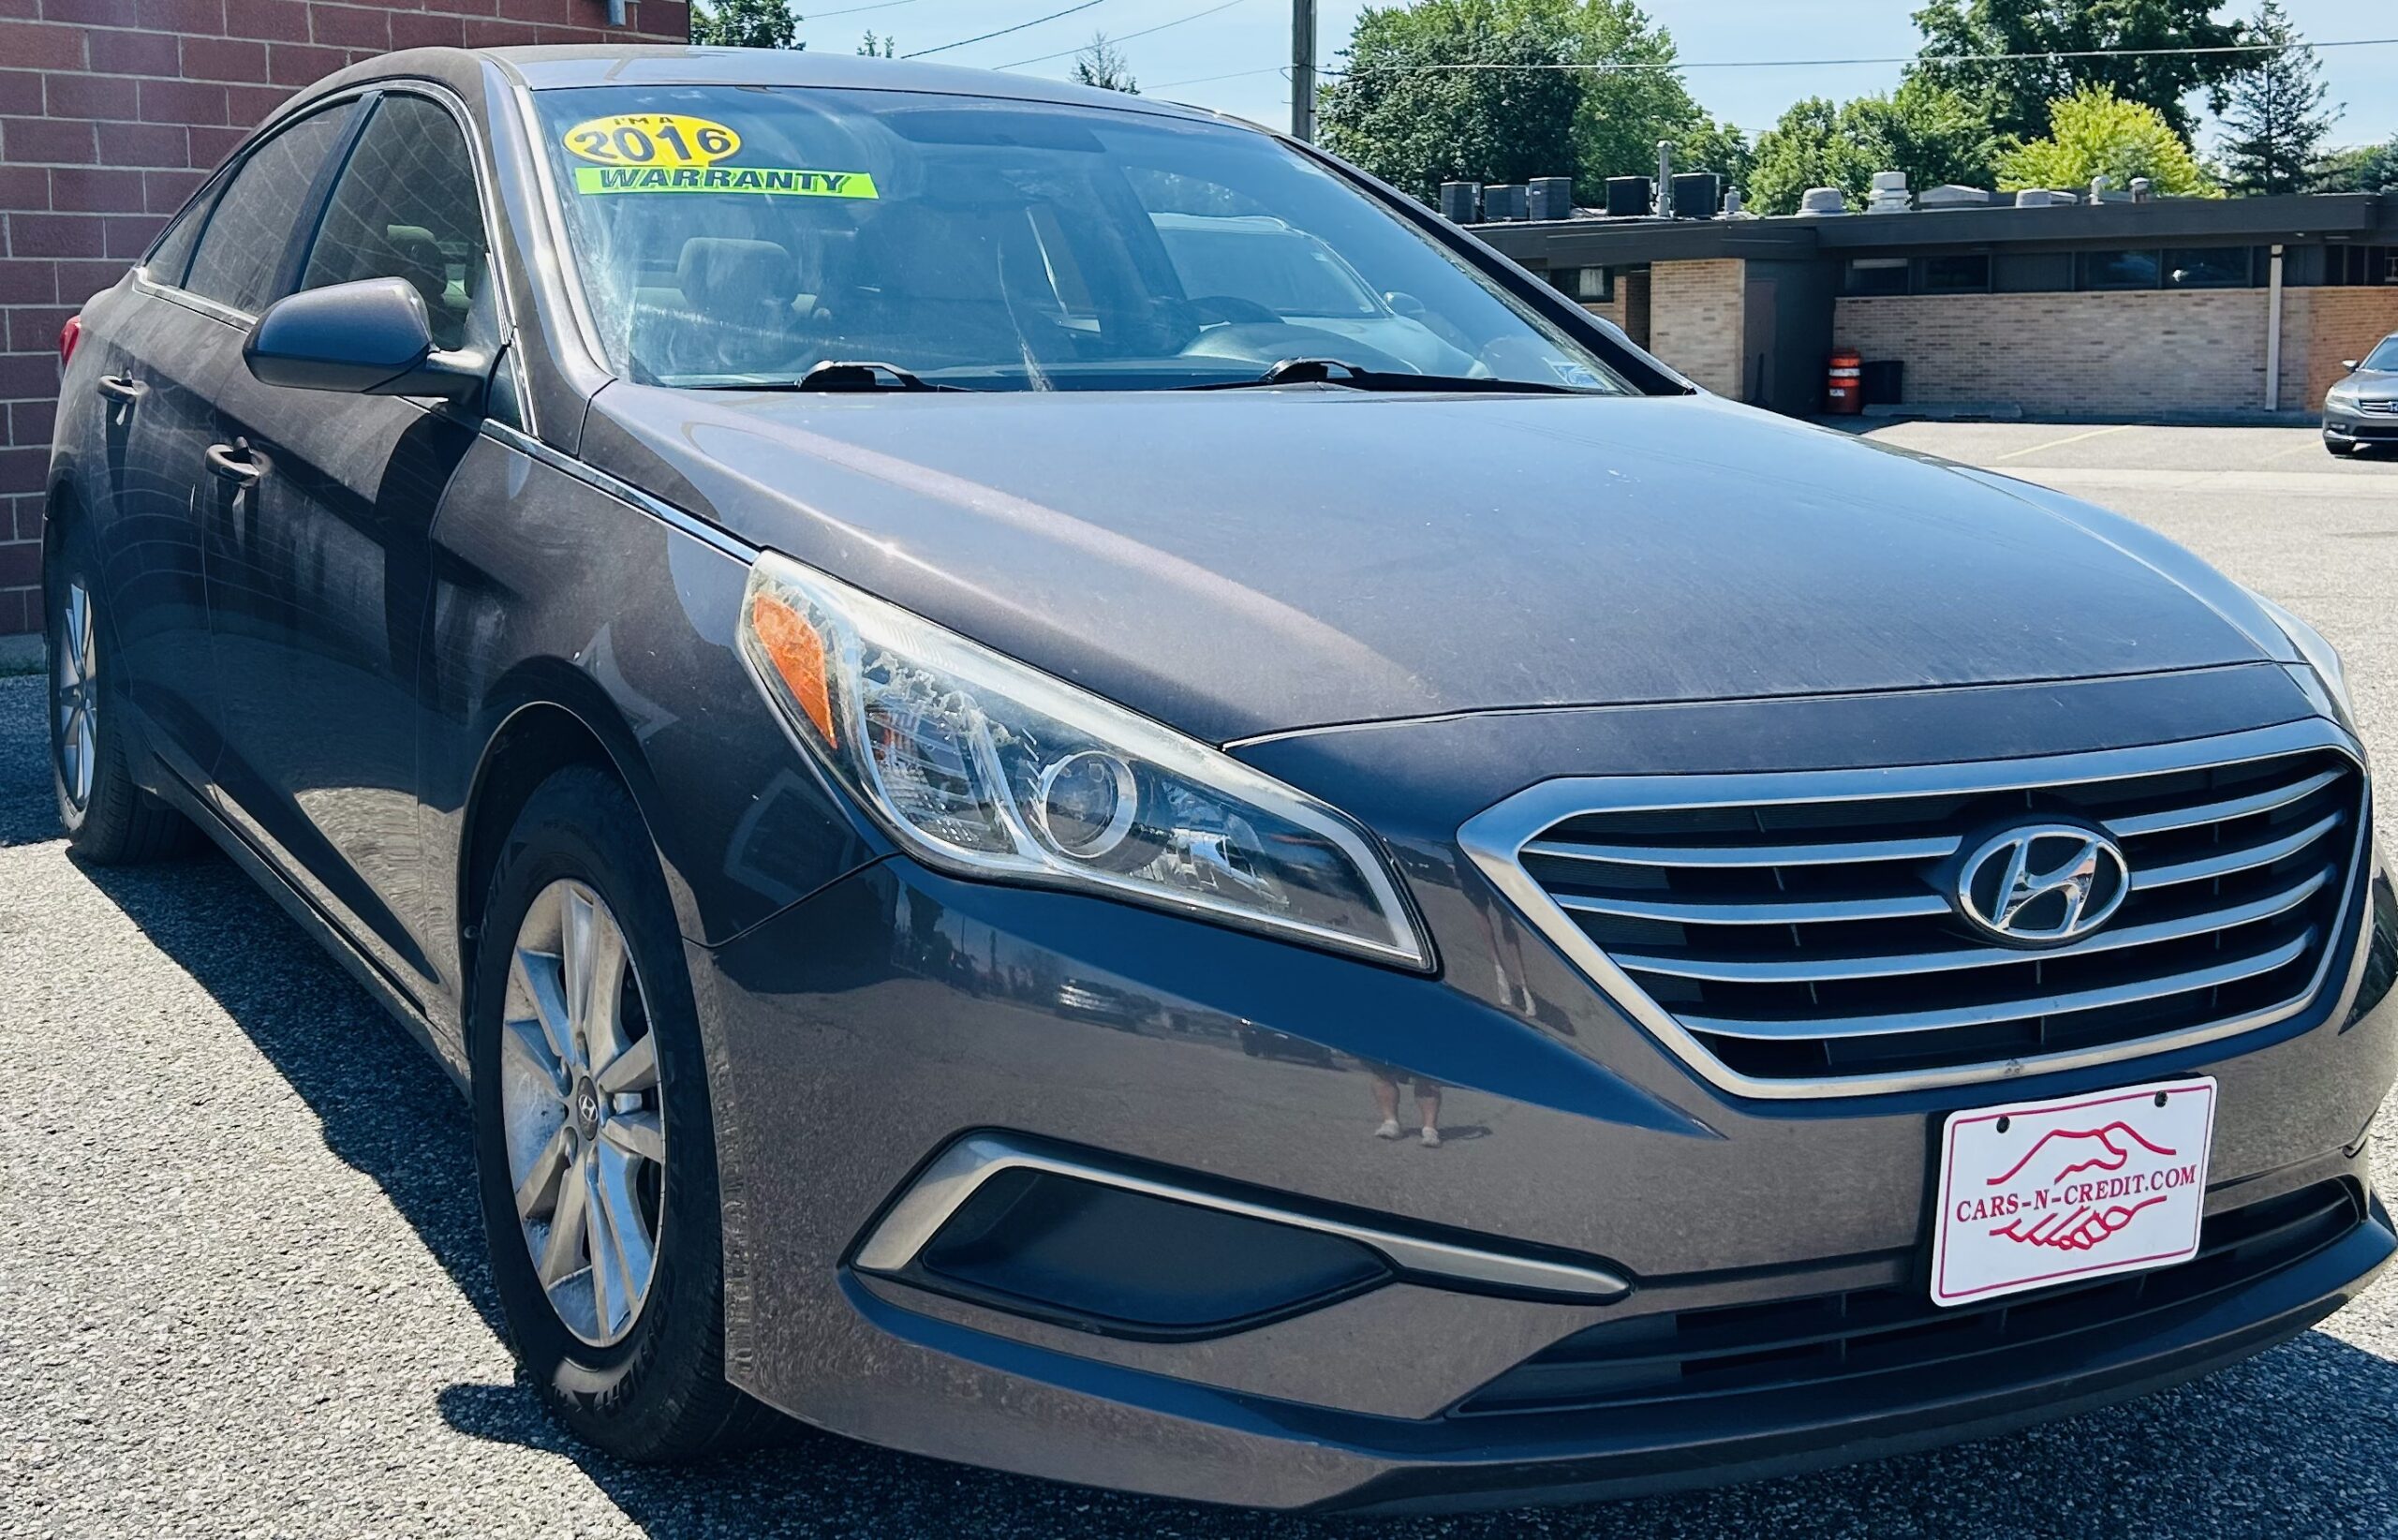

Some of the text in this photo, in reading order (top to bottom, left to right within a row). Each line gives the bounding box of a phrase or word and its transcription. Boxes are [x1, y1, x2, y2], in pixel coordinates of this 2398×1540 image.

[614, 116, 649, 126] I'M
[574, 126, 732, 162] 2016
[600, 168, 851, 193] WARRANTY
[1956, 1164, 2196, 1222] CARS-N-CREDIT.COM
